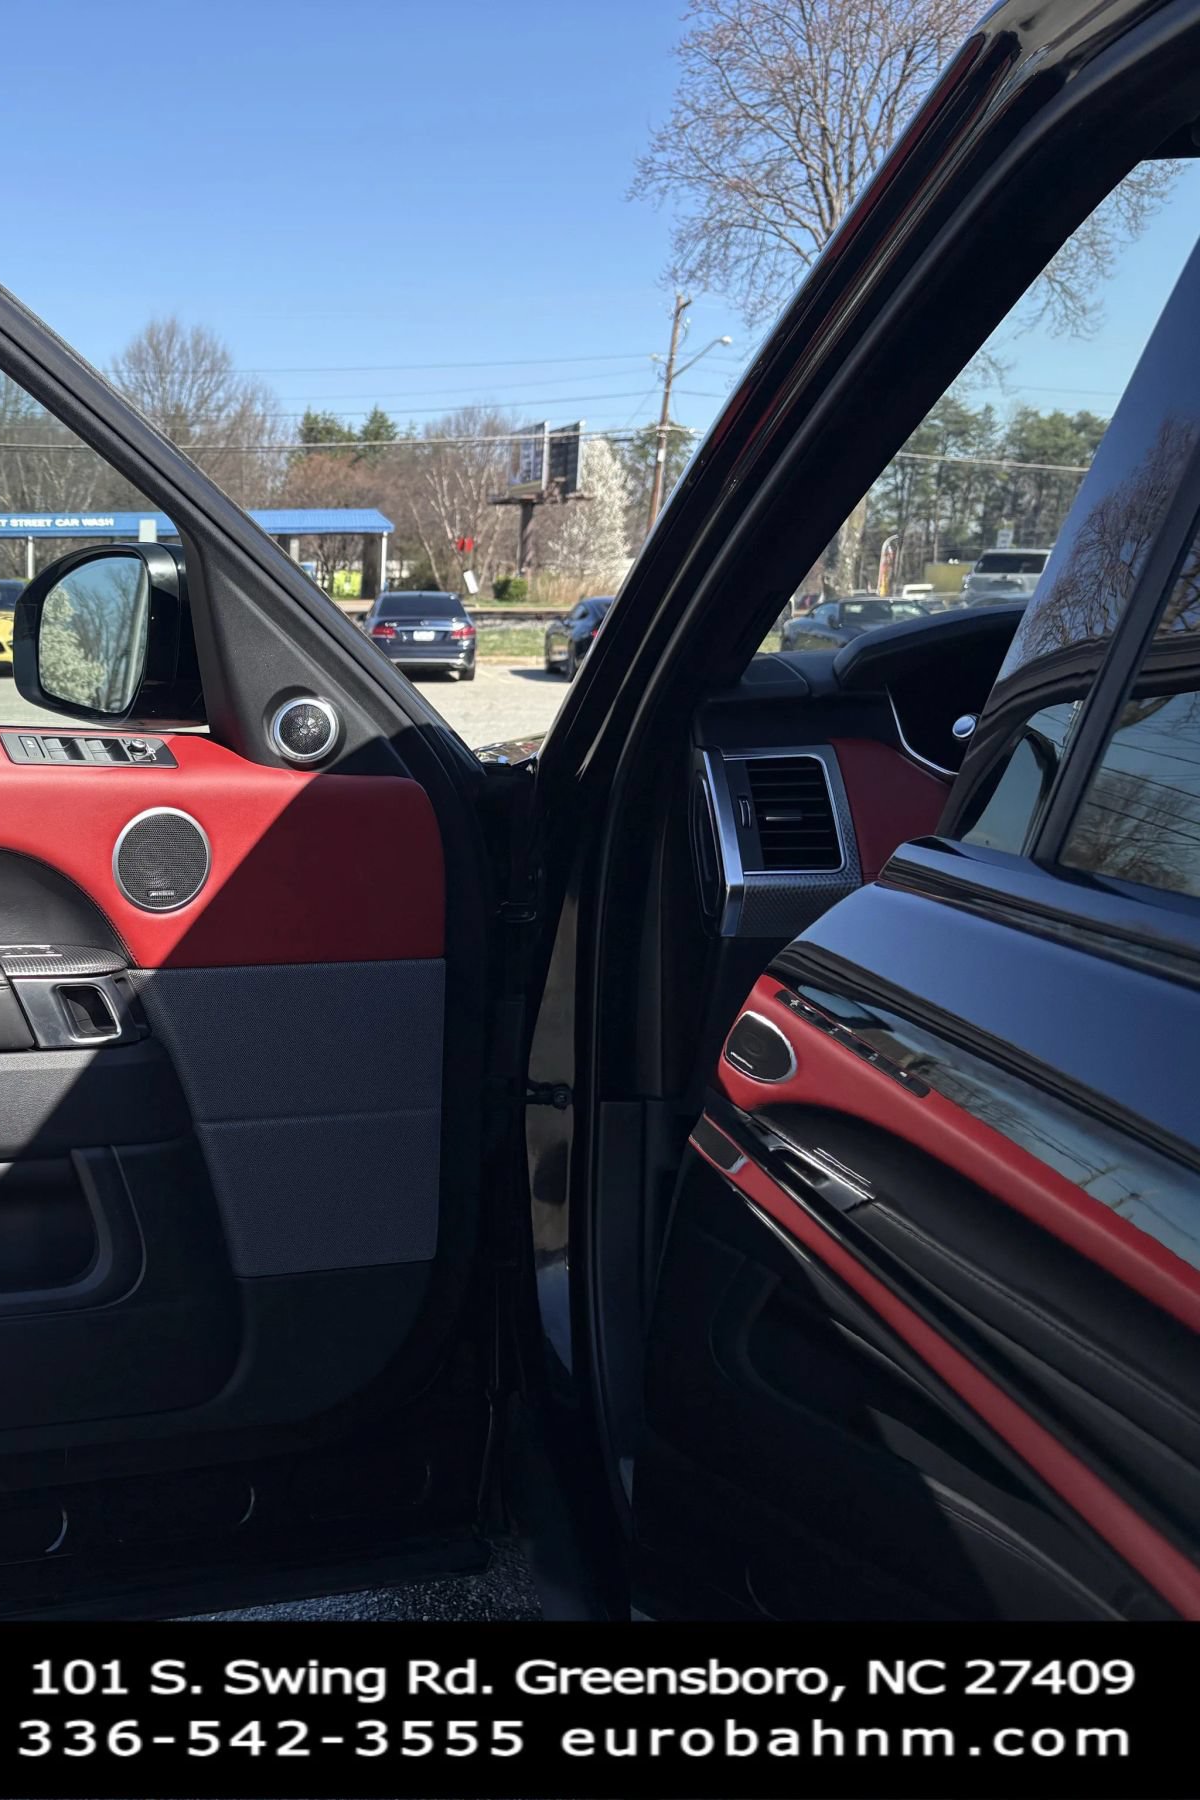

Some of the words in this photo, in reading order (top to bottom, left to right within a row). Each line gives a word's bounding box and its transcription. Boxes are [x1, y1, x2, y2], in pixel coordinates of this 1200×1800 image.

[9, 518, 53, 528] STREET
[54, 518, 80, 527] CAR
[81, 518, 114, 527] WASH
